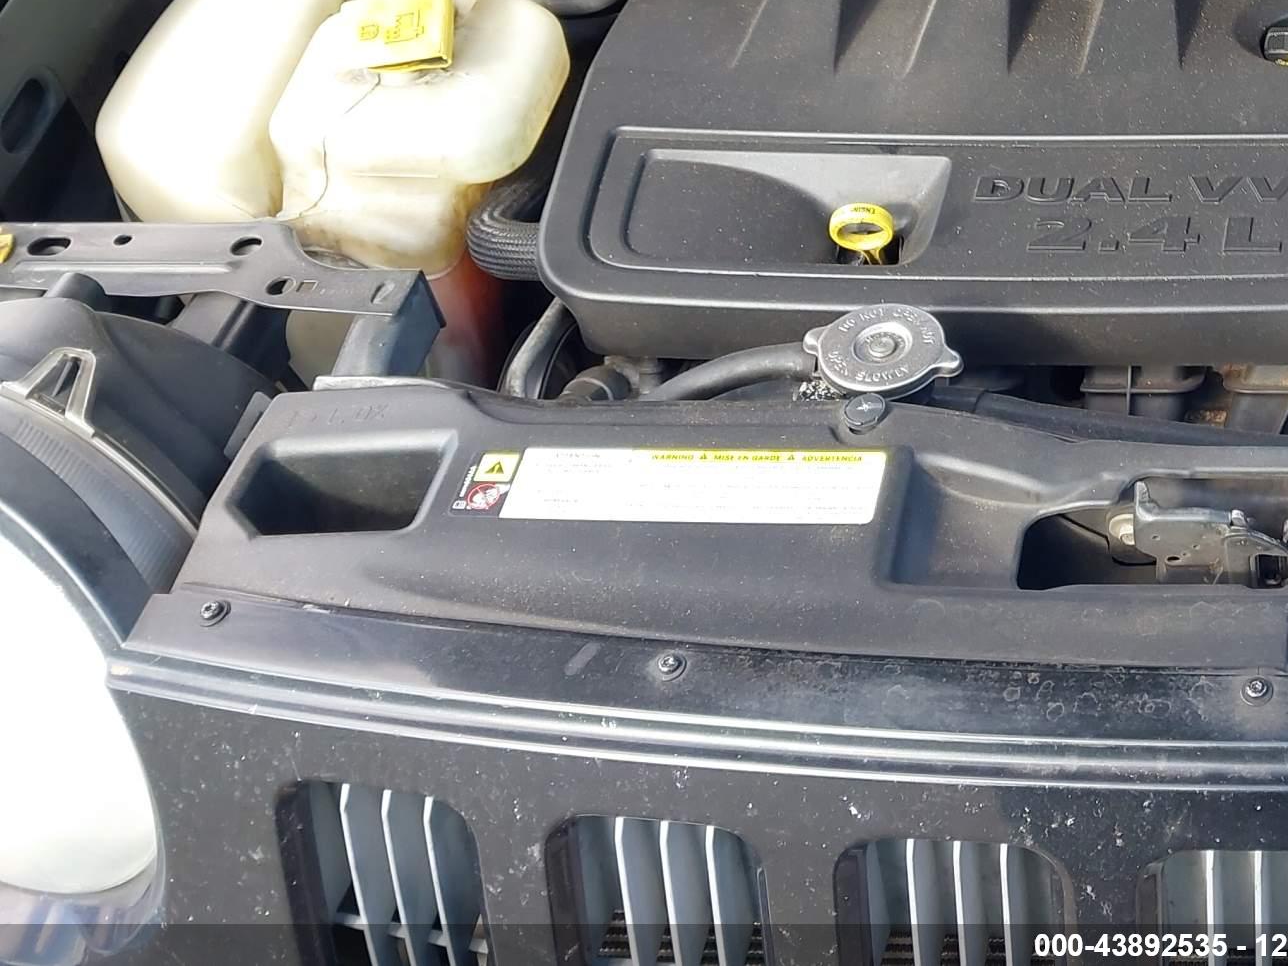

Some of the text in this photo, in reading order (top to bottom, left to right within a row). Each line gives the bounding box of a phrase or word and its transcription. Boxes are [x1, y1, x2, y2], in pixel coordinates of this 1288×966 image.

[974, 175, 1174, 203] DUAL
[838, 319, 856, 333] DO
[858, 308, 886, 322] NOT
[854, 366, 910, 383] SLOWLY
